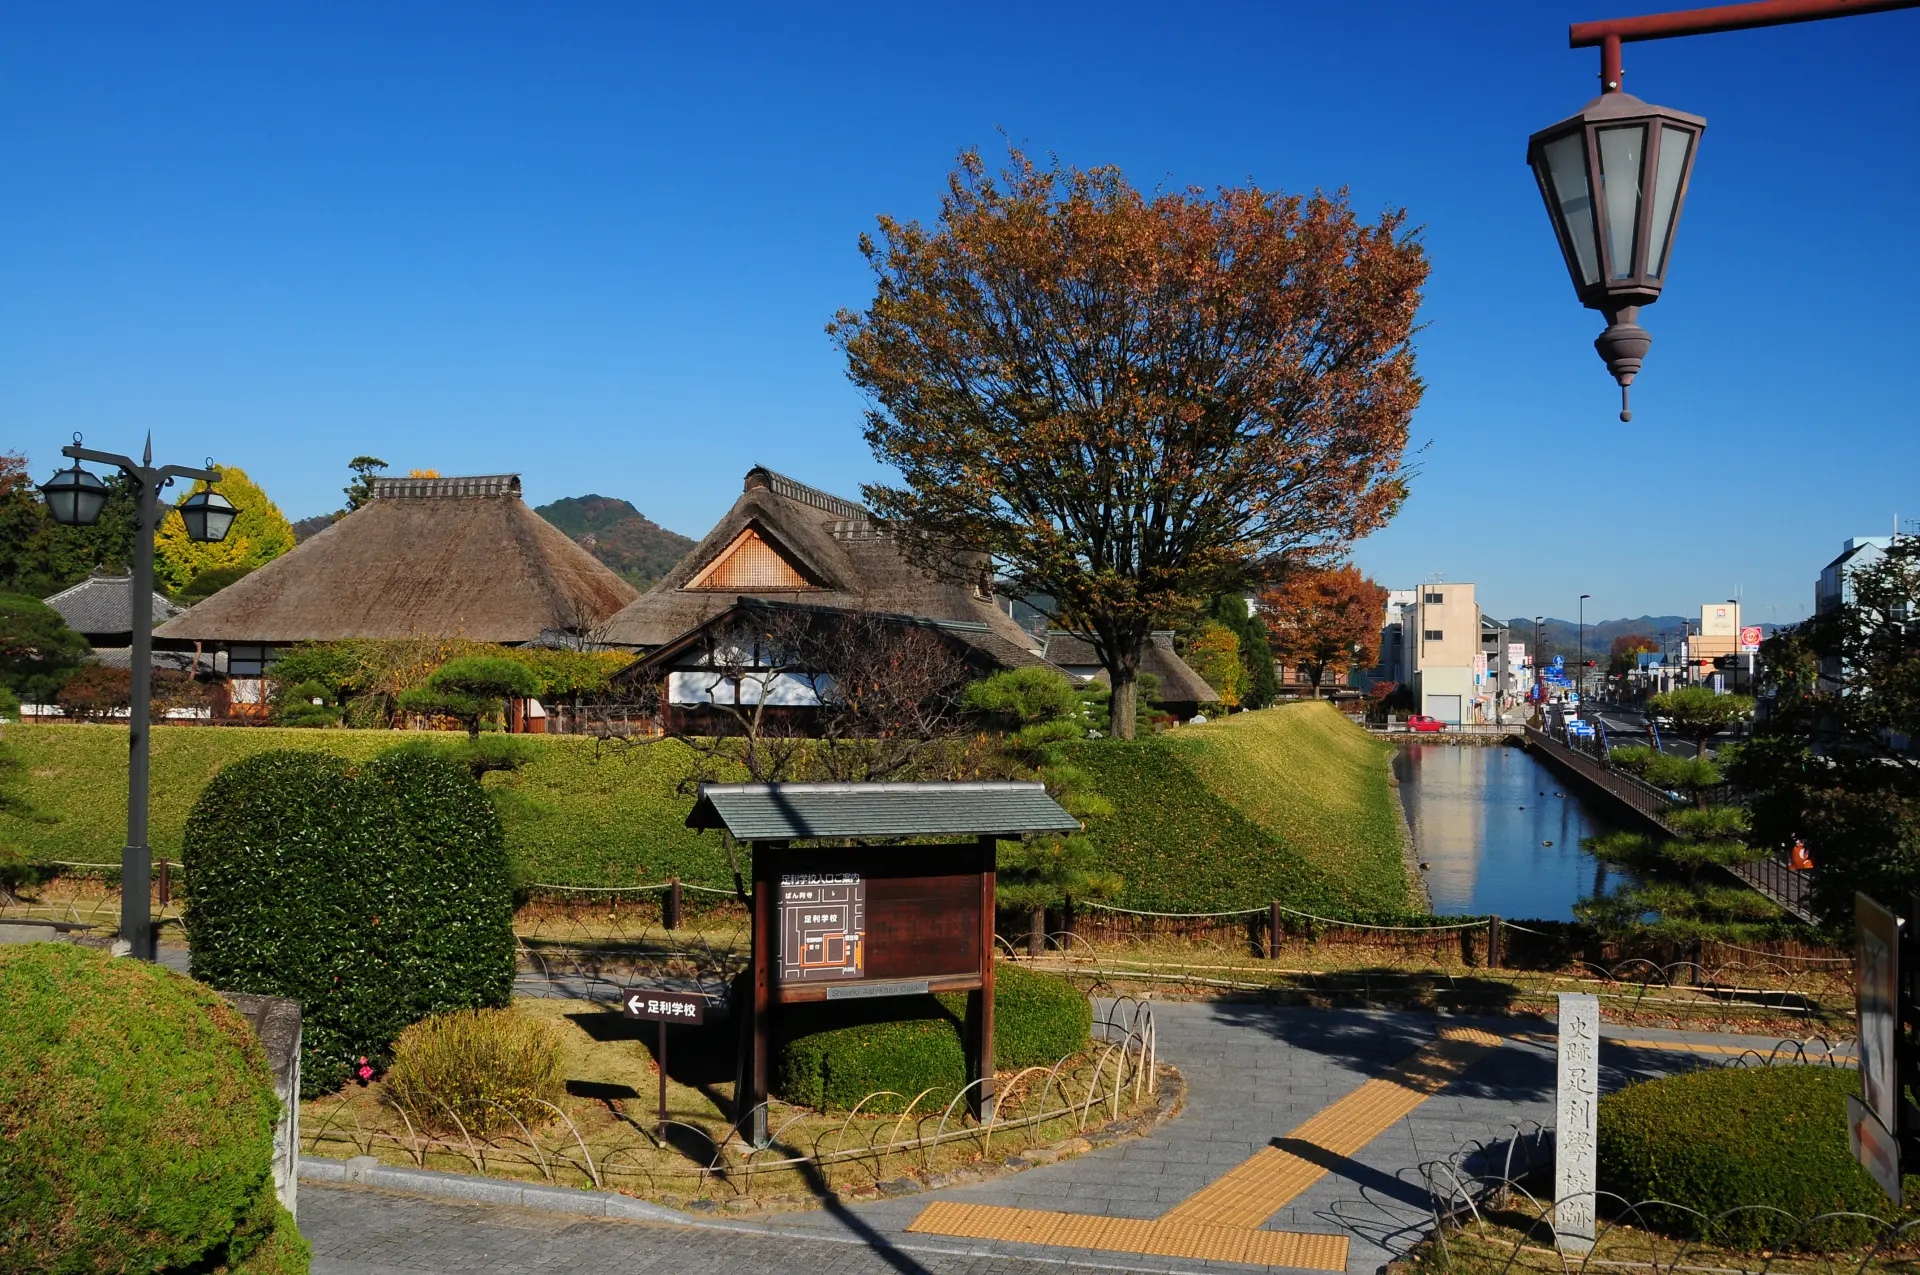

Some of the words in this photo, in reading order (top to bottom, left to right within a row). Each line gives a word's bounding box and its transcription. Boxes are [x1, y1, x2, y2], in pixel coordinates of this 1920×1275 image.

[781, 873, 860, 885] 足利学校入口ご案内
[803, 914, 838, 923] 足利学校
[863, 986, 898, 995] Ashikaga
[647, 1000, 696, 1017] 足利学校
